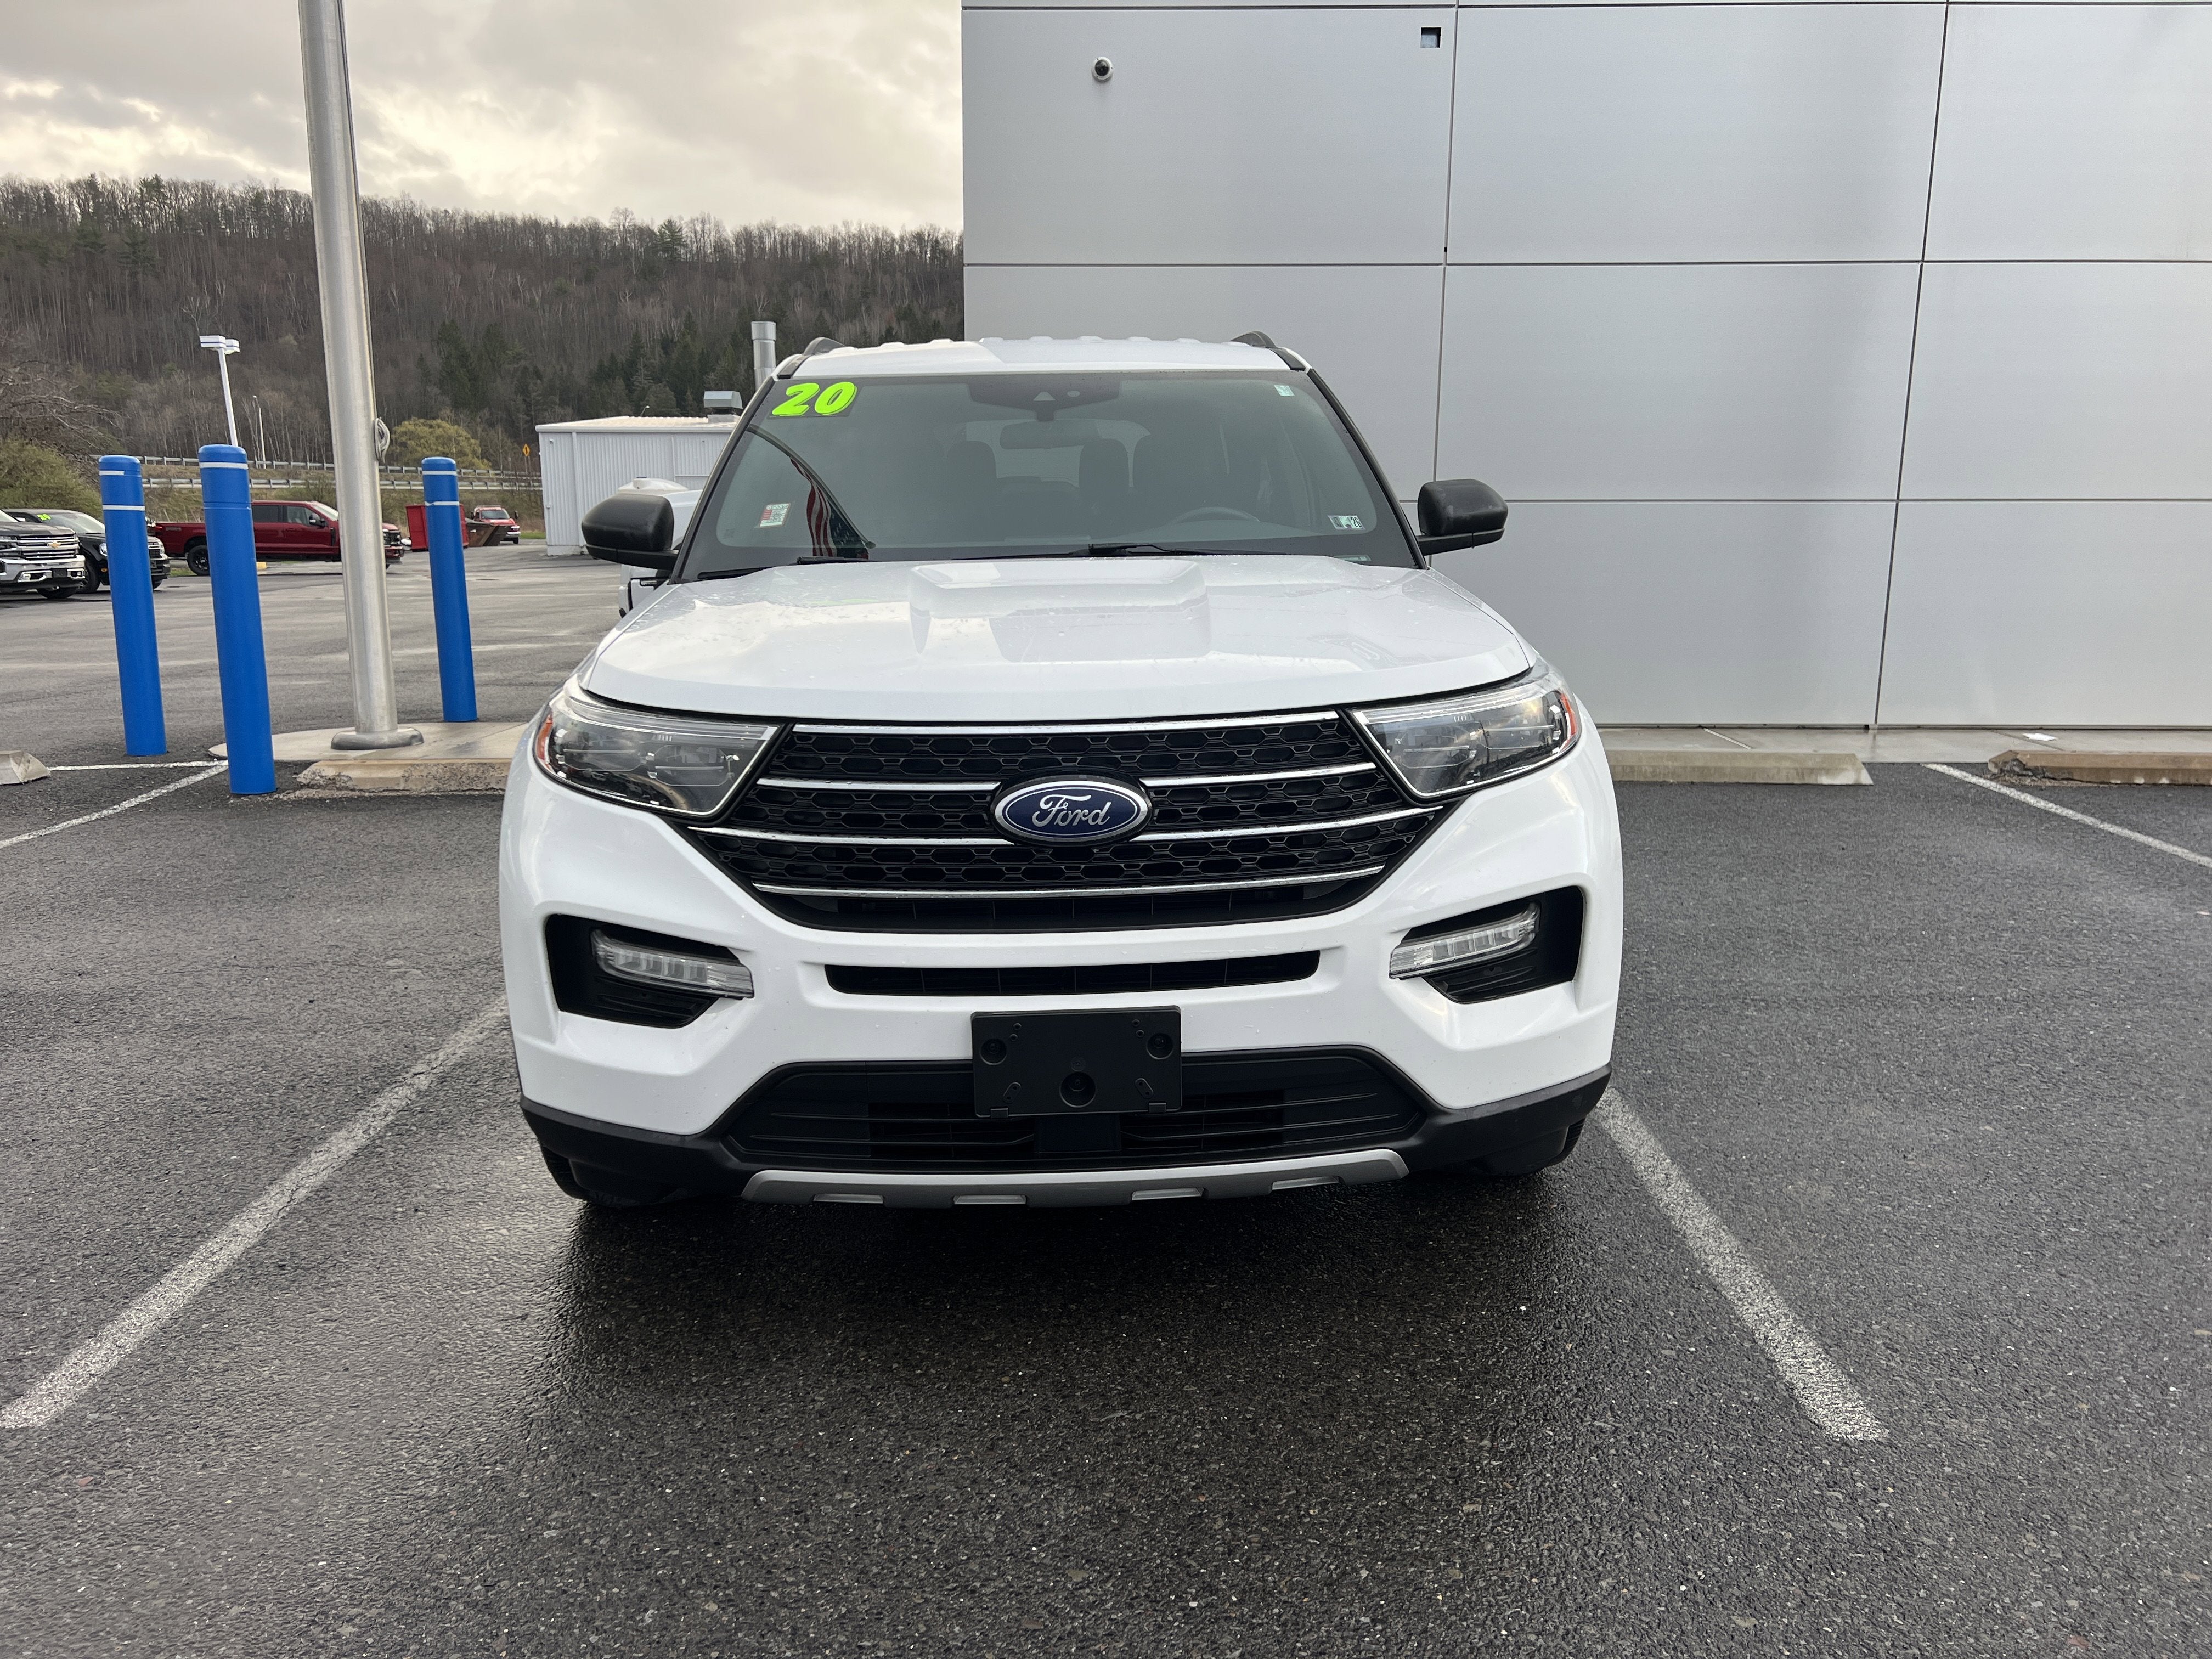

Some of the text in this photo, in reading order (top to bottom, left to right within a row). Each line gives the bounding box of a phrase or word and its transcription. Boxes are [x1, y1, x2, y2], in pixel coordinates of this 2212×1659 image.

[772, 382, 857, 416] 20
[1350, 517, 1362, 527] 26
[1032, 794, 1111, 827] Ford
